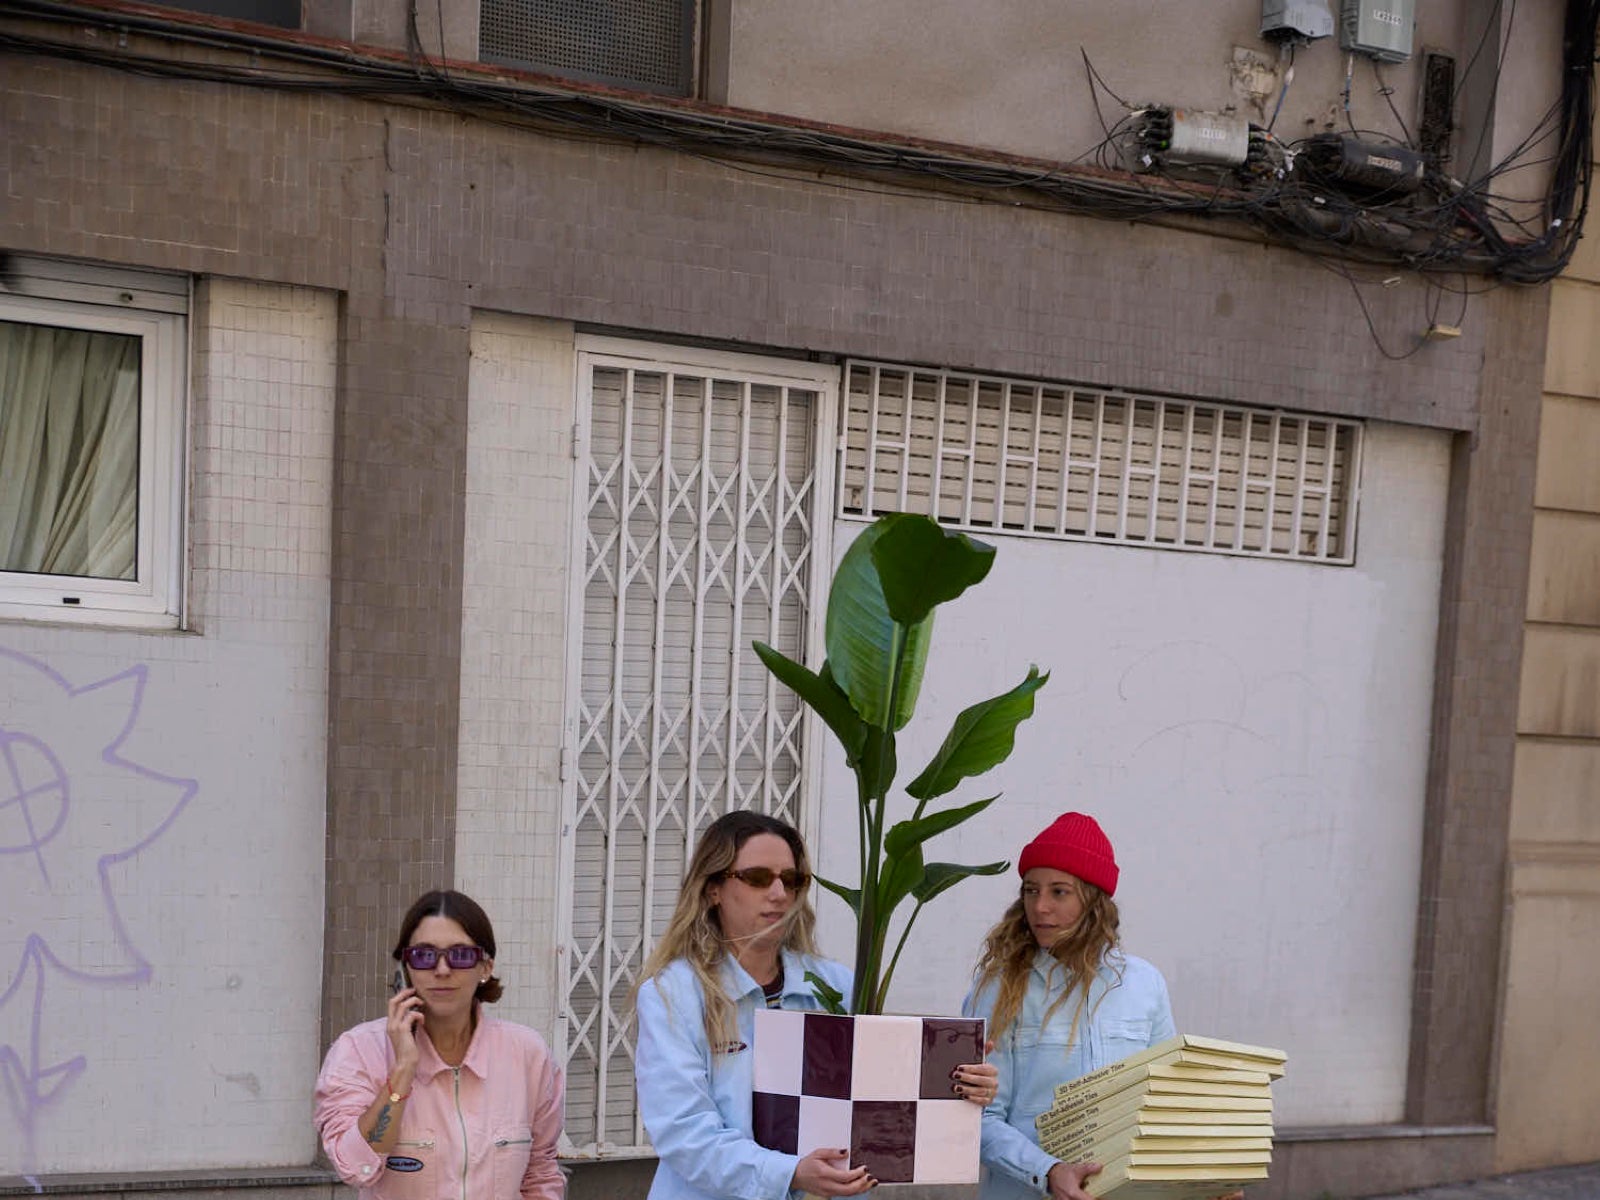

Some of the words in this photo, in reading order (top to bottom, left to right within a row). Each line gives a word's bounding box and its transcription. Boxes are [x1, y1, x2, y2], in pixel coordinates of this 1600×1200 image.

[1068, 1069, 1109, 1089] Self-Adhesive
[1110, 1063, 1125, 1073] Tiles
[1049, 1099, 1084, 1119] Self-Adhesive
[1084, 1092, 1098, 1101] Tiles
[1050, 1113, 1085, 1132] Self-Adhesive
[1085, 1107, 1099, 1116] Tiles
[1051, 1128, 1085, 1147] Self-Adhesive
[1085, 1122, 1098, 1130] Tiles
[1082, 1136, 1094, 1146] Tiles
[1082, 1151, 1094, 1160] Tiles
